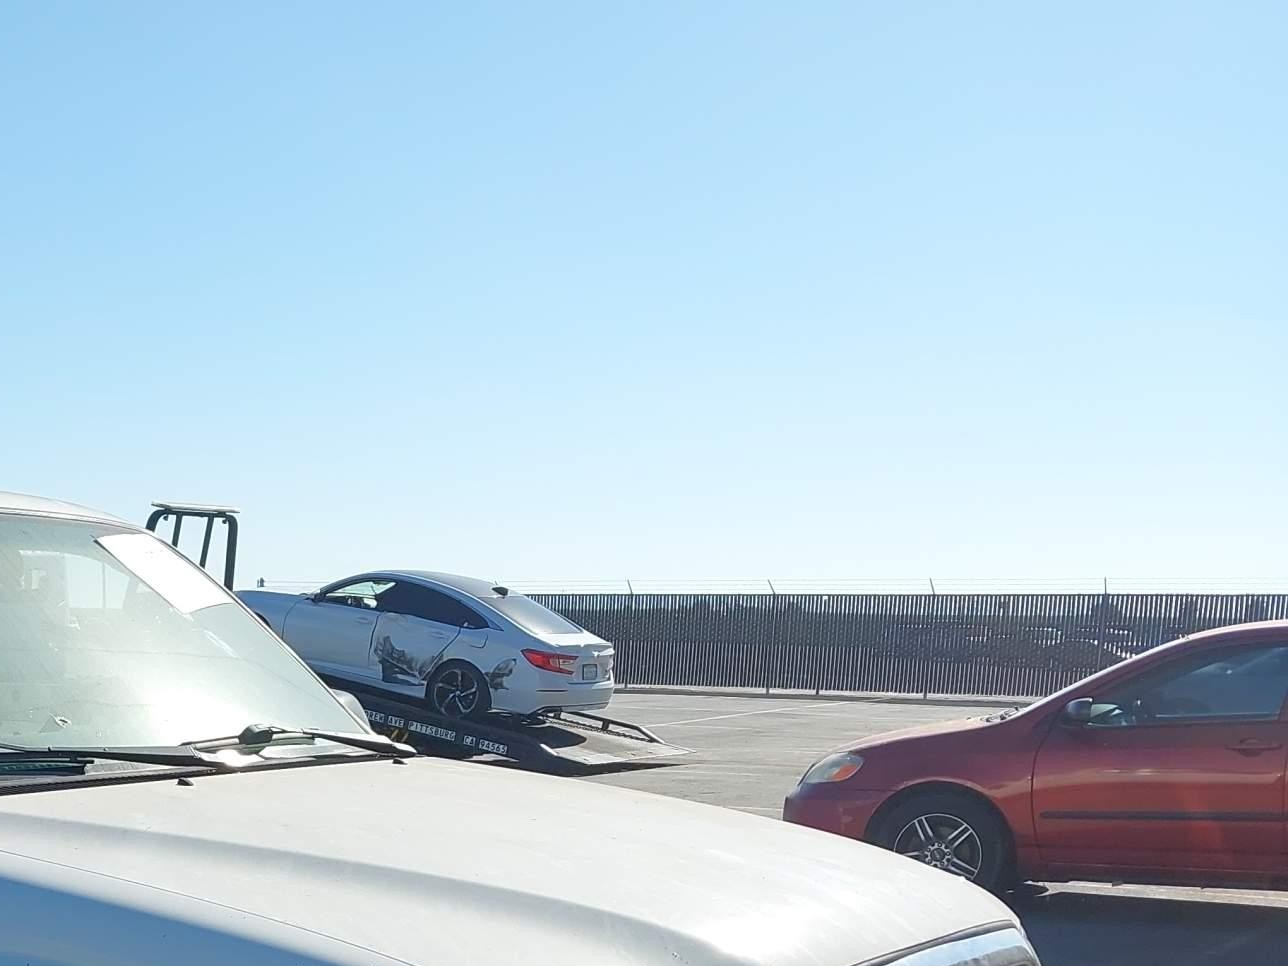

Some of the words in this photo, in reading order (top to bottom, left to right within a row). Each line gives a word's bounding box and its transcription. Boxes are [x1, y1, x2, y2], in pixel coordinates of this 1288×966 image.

[388, 715, 405, 728] AVE
[408, 720, 456, 741] PITTSBURG
[463, 735, 476, 747] CA
[478, 739, 508, 754] 94565
